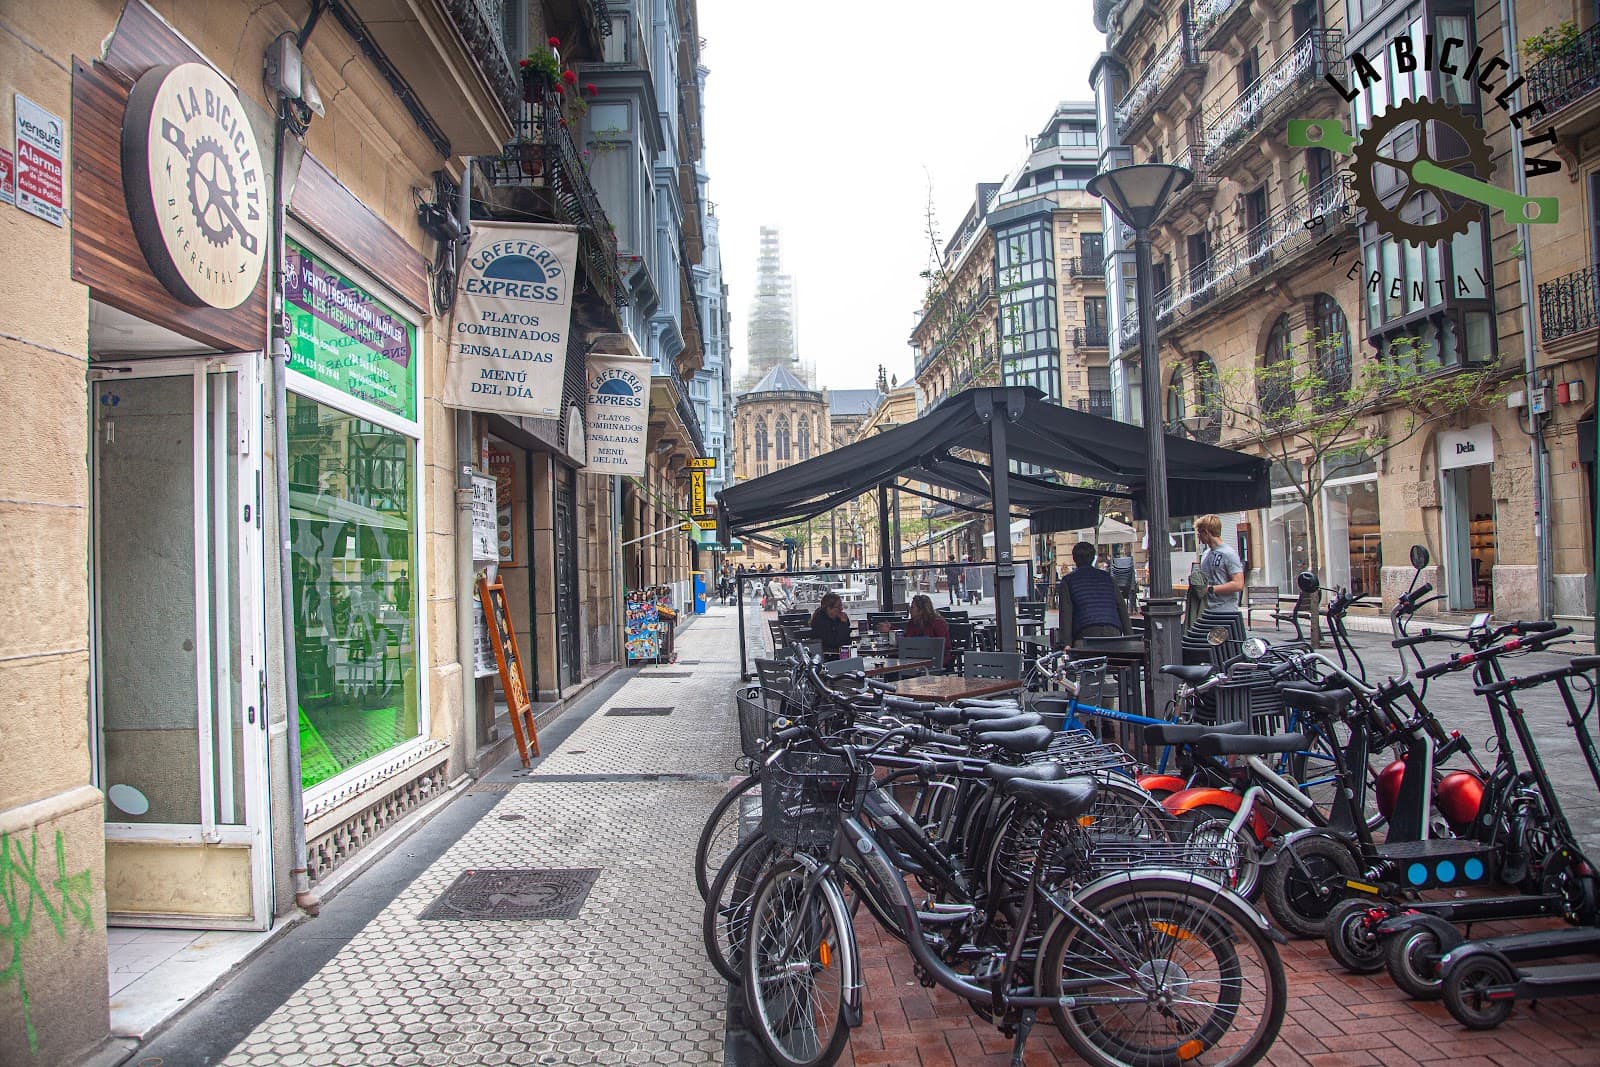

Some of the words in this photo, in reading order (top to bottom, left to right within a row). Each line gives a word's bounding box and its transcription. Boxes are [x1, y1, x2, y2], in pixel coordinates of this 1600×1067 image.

[20, 143, 61, 176] Alarma
[177, 86, 201, 123] LA
[205, 87, 260, 221] BICICLETA
[471, 242, 561, 278] CAFETERIA
[466, 279, 558, 300] EXPRESS
[302, 267, 327, 296] VENTA
[332, 287, 372, 327] REPARACIÓN
[375, 315, 402, 344] ALQUILER
[302, 287, 326, 313] SALES
[358, 321, 385, 349] RENTALS
[481, 311, 539, 326] PLATOS
[457, 322, 560, 343] COMBINADOS
[459, 343, 553, 363] ENSALADAS
[480, 368, 527, 383] MENÚ
[590, 369, 643, 393] CAFETERIA
[470, 382, 502, 396] DEL
[506, 384, 533, 398] DÍA
[588, 394, 641, 407] EXPRESS
[597, 413, 630, 422] PLATOS
[1456, 442, 1475, 454] Dela
[592, 456, 610, 464] DEL
[686, 459, 708, 467] BAR
[694, 475, 702, 515] VALLES
